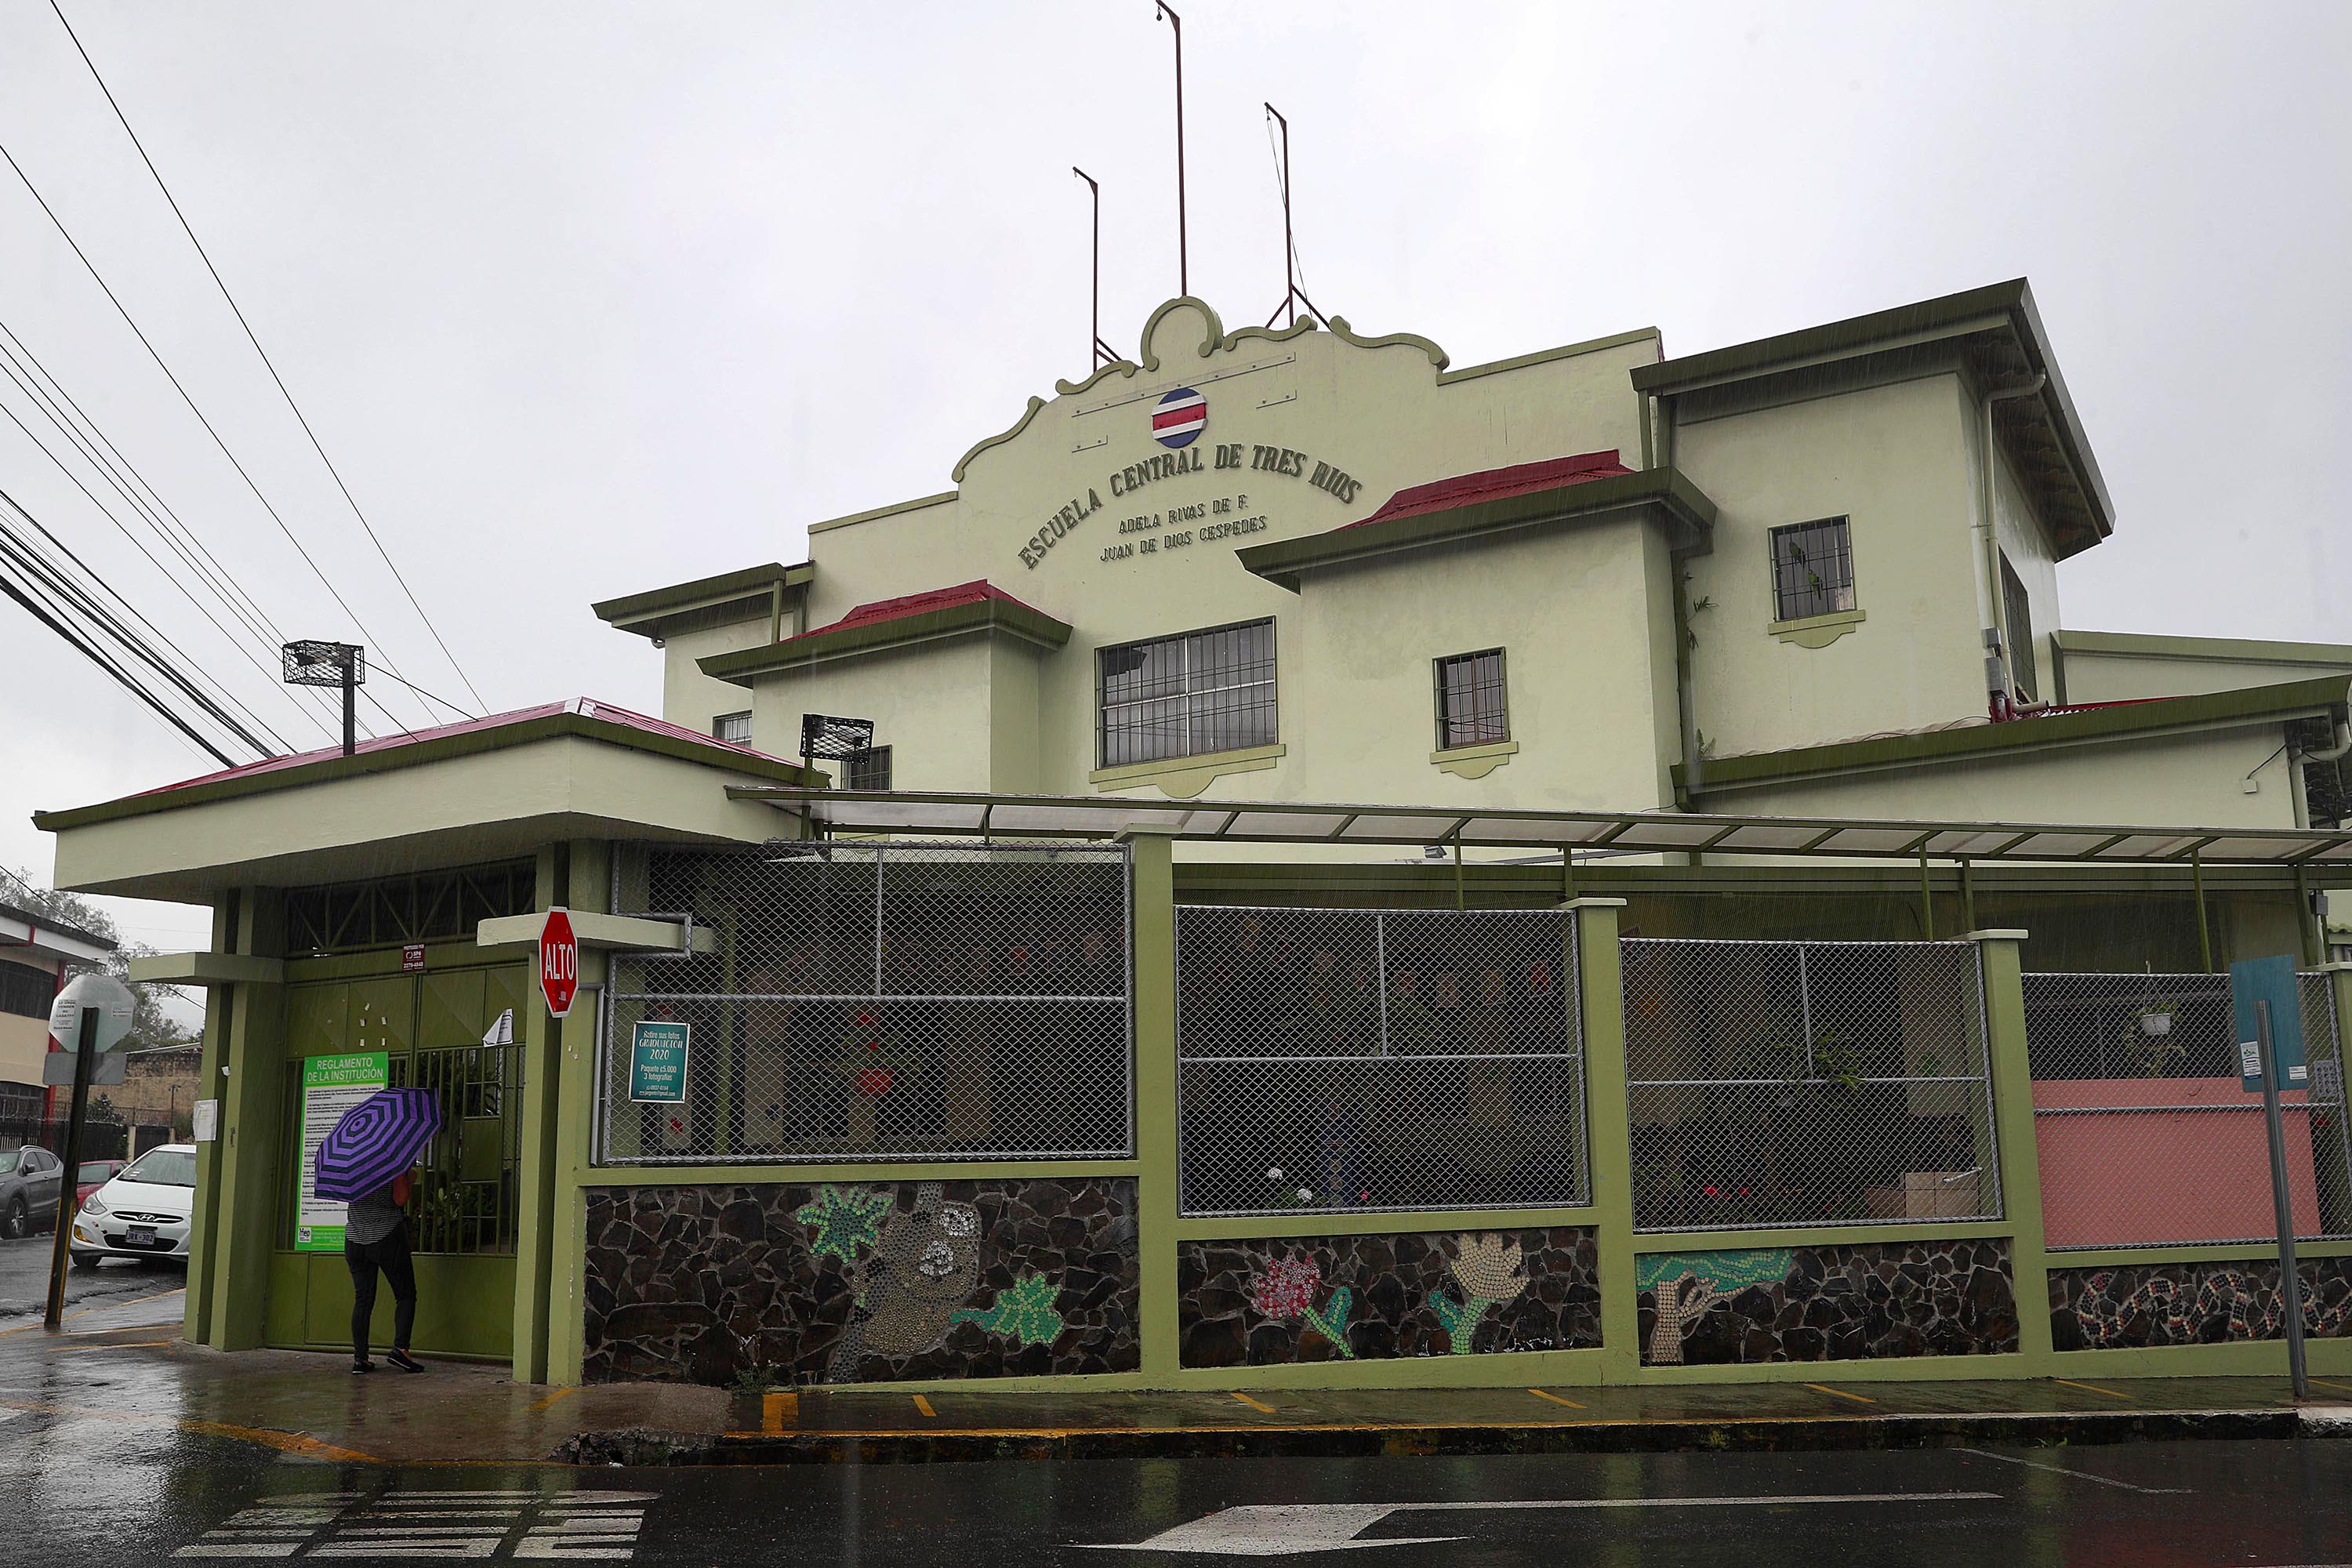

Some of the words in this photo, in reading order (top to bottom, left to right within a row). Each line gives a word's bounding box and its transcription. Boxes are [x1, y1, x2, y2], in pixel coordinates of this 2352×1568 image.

[1018, 488, 1103, 570] ESCUELA
[1109, 447, 1203, 497] CENTRAL
[1214, 444, 1243, 469] DE
[1250, 445, 1308, 477] TRES
[1308, 460, 1363, 504] RIOS
[1118, 514, 1161, 535] ADELA
[1168, 502, 1206, 524] RIVAS
[1212, 498, 1232, 514] DE
[1100, 543, 1134, 561] JUAN
[1140, 538, 1157, 554] DE
[1164, 530, 1192, 549] DIOS
[1200, 514, 1268, 542] CESPEDES
[545, 943, 575, 980] ALTO
[317, 1058, 372, 1069] REGLAMENTO
[650, 1049, 670, 1060] 2020
[307, 1072, 318, 1082] DE
[319, 1072, 329, 1081] LA
[331, 1066, 383, 1080] INSTITUCIÓN
[641, 1065, 659, 1073] Paquete
